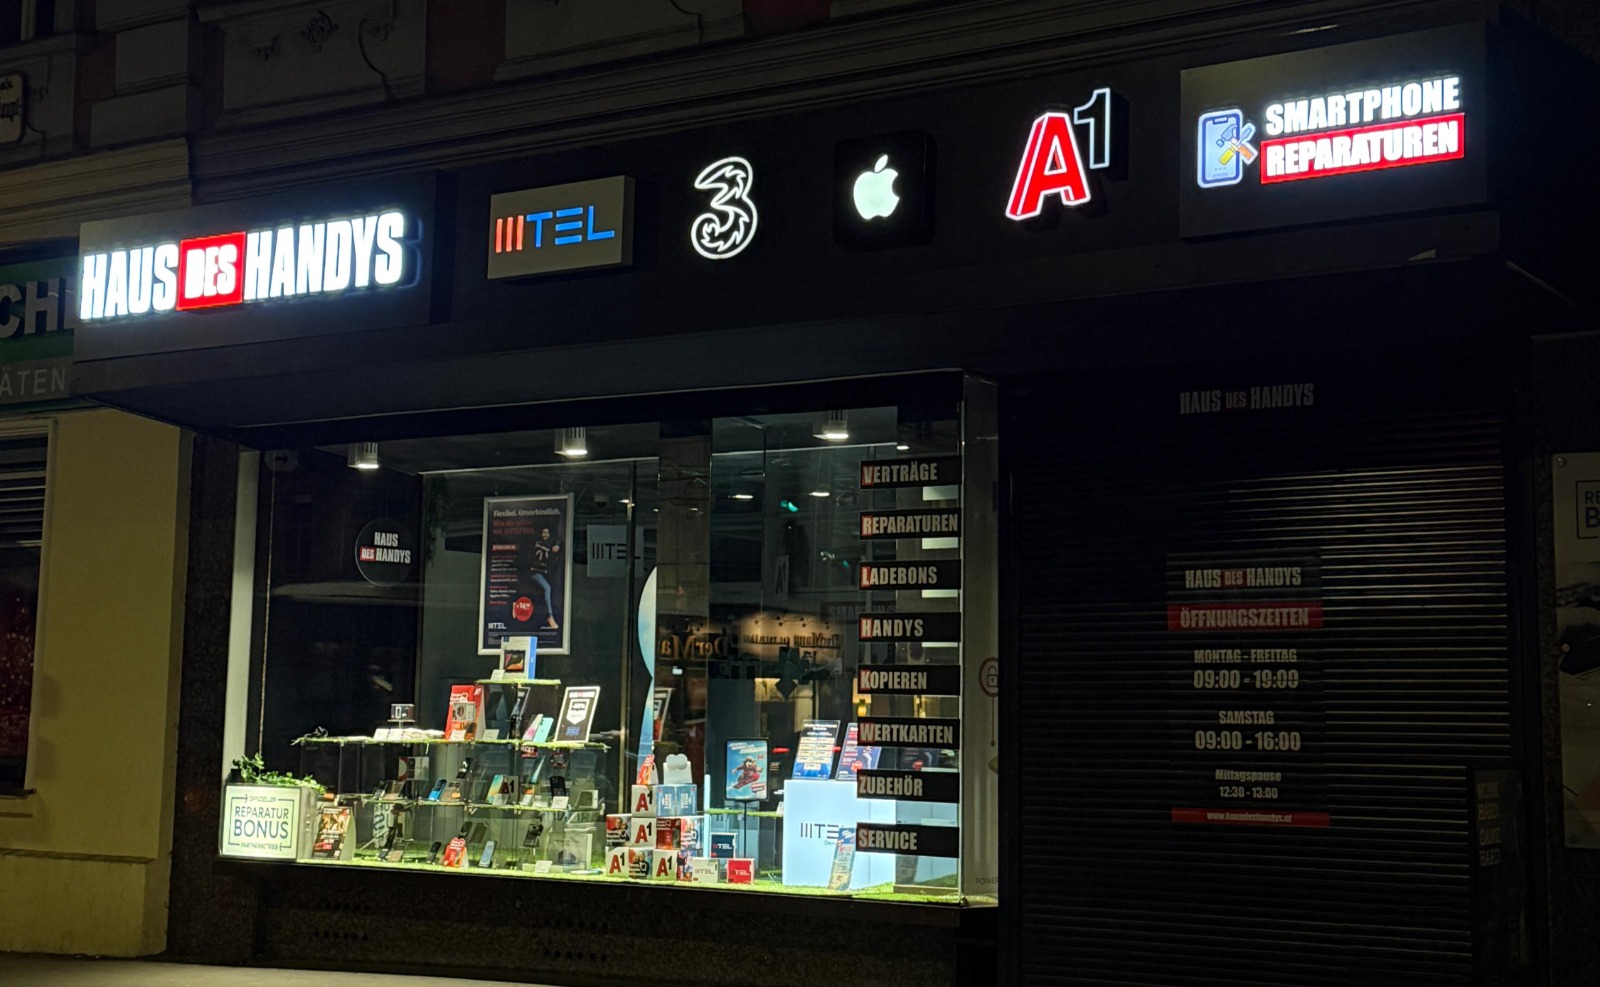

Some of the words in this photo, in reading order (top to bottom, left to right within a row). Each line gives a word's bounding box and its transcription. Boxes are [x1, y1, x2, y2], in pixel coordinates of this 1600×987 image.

[1265, 77, 1460, 136] SMARTPHONE
[1005, 87, 1111, 221] A1
[1266, 120, 1459, 177] REPARATUREN
[690, 156, 758, 261] 3
[80, 243, 179, 320] HAUS
[184, 244, 238, 299] DES
[243, 211, 404, 301] HANDYS
[1179, 389, 1222, 415] HAUS
[1225, 391, 1247, 409] DES
[1250, 383, 1314, 410] HANDYS
[863, 461, 938, 484] VERTRÄGE
[862, 514, 958, 536] REPARATUREN
[374, 531, 399, 548] HAUS
[361, 548, 375, 560] DES
[375, 547, 412, 564] HANDYS
[861, 566, 938, 586] LADEBONS
[1185, 569, 1222, 588] HAUS
[1224, 570, 1243, 586] DES
[1246, 567, 1302, 587] HANDYS
[1180, 606, 1309, 628] ÖFFNUNGSZEITEN
[860, 618, 924, 638] HANDYS
[1193, 648, 1241, 663] MONTAG
[1250, 648, 1297, 663] FREITAG
[860, 670, 927, 691] KOPIEREN
[1193, 668, 1241, 689] 09:00
[1252, 668, 1299, 689] 19:00
[1218, 710, 1275, 725] SAMSTAG
[859, 722, 953, 744] WERTKARTEN
[1194, 730, 1243, 750] 09:00
[1254, 731, 1302, 750] 16:00
[859, 774, 923, 797] ZUBEHÖR
[1215, 768, 1282, 782] Mittagspause
[636, 790, 653, 812] A1
[1219, 786, 1245, 798] 12:30
[1251, 787, 1279, 799] 13:00
[234, 805, 289, 819] REPARATUR
[233, 820, 289, 839] BONUS
[635, 822, 652, 844] A1
[858, 829, 918, 850] SERVICE
[609, 852, 625, 874] A1
[656, 856, 673, 877] A1
